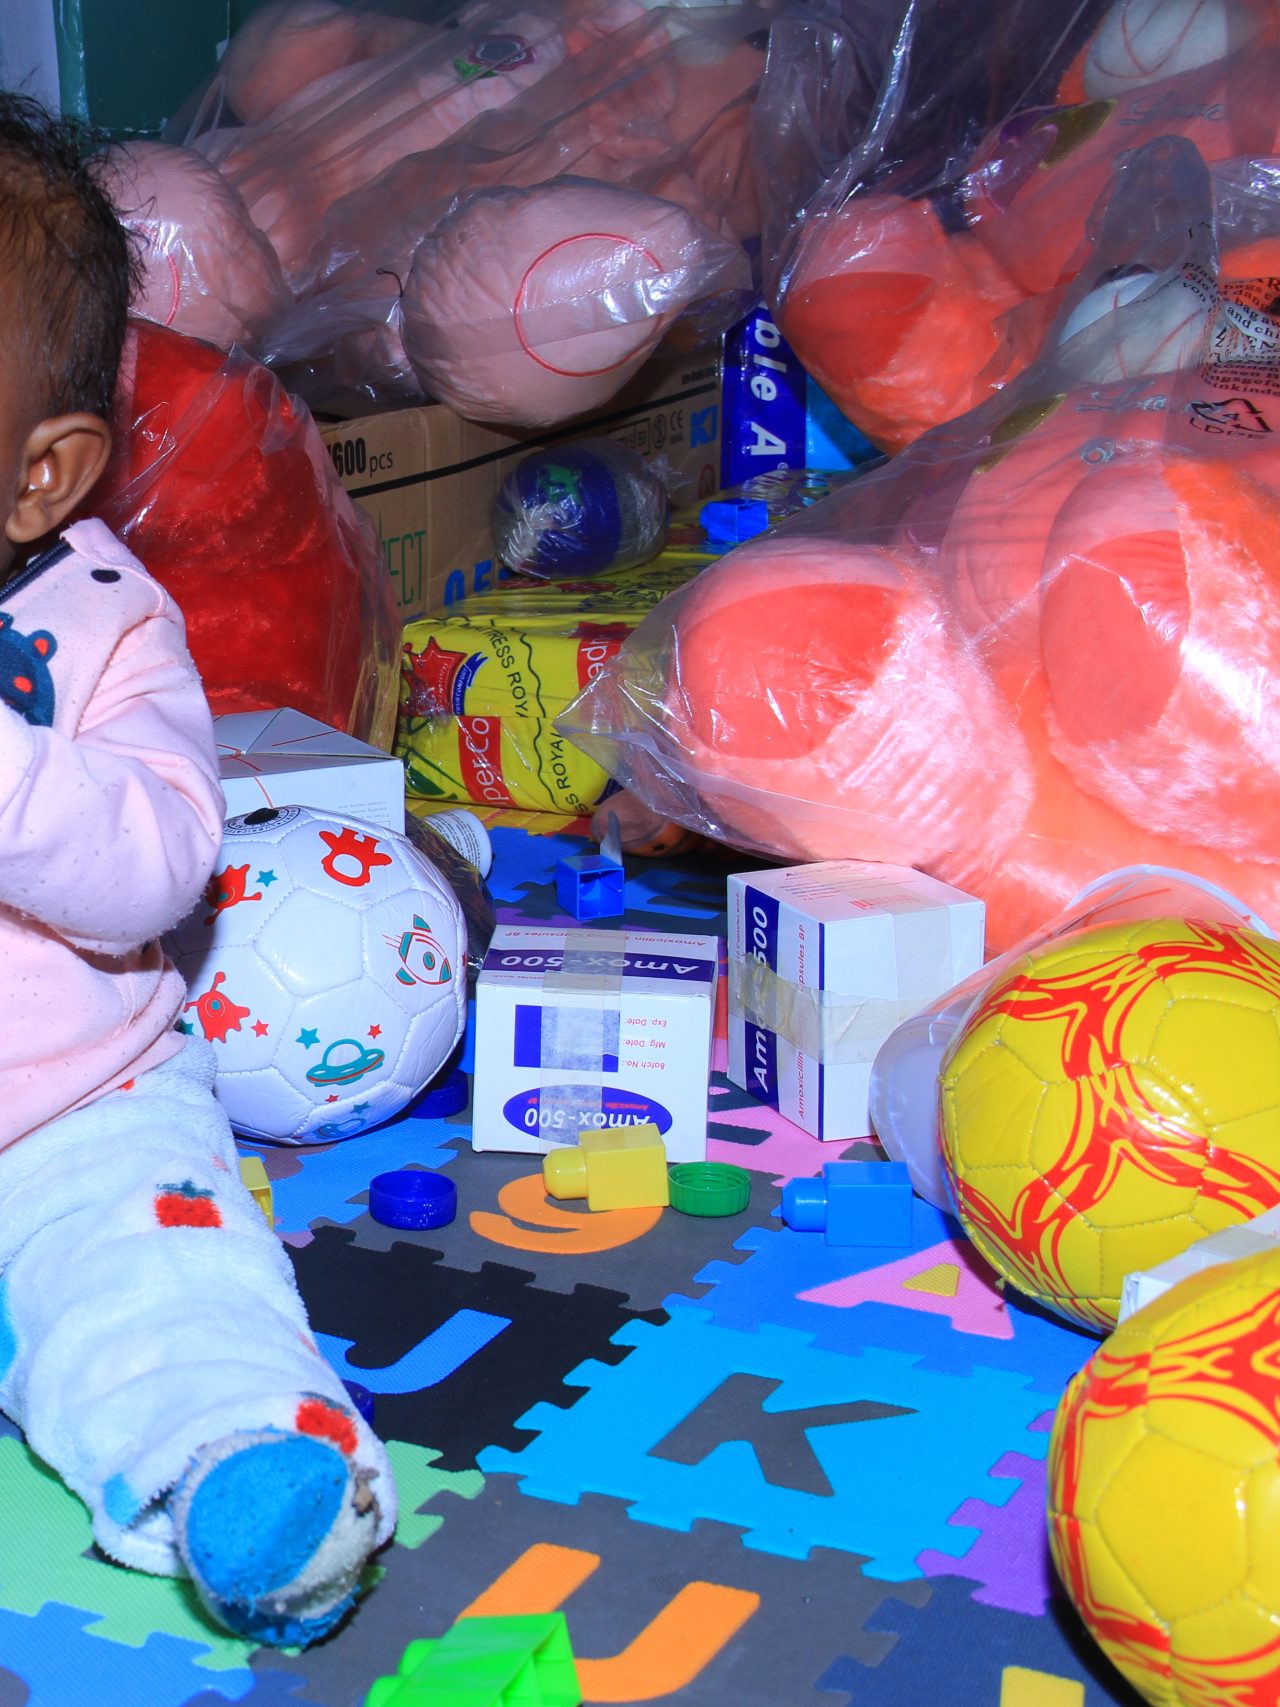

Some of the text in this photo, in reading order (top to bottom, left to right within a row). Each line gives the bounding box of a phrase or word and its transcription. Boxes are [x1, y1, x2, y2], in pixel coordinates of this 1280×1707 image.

[326, 436, 395, 477] 600 pcs
[634, 936, 707, 947] Amoxicillin
[798, 924, 806, 942] BP
[500, 955, 701, 975] Amox-500
[624, 1017, 668, 1028] Exp. Date:
[622, 1039, 666, 1049] Mfg. Date:
[641, 1061, 666, 1070] Batch
[795, 1051, 805, 1120] Amoxicillin
[795, 1240, 1014, 1341] A
[645, 1372, 920, 1497] K
